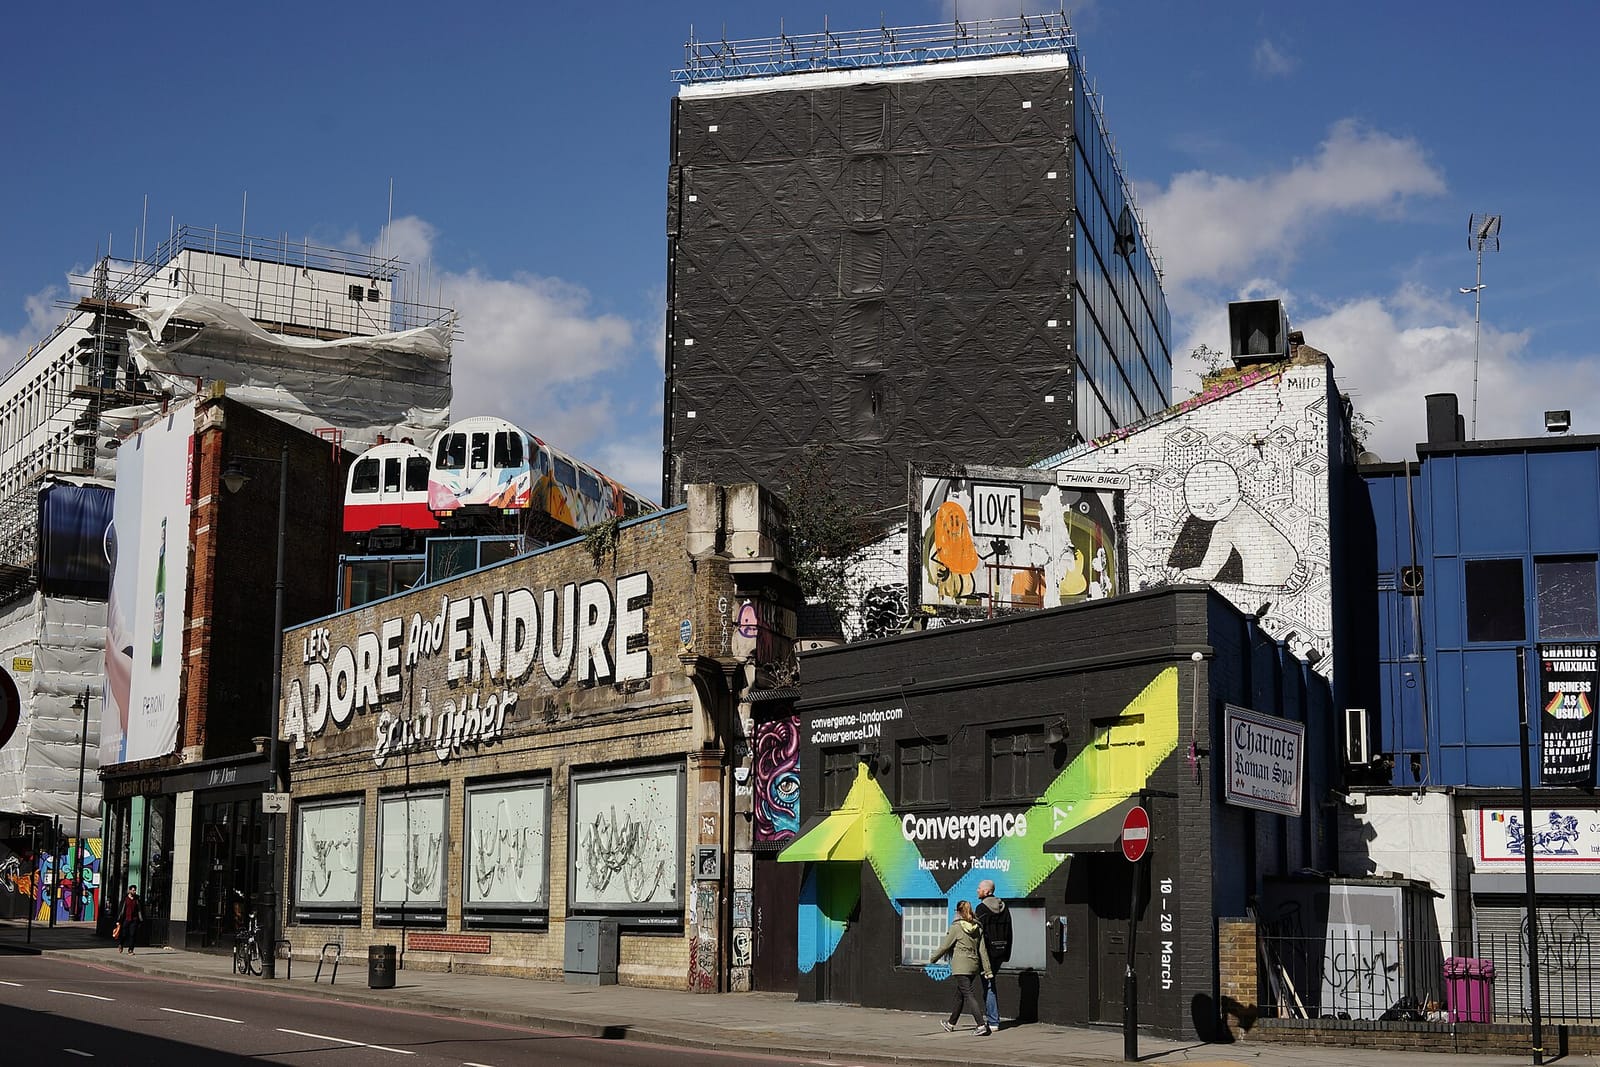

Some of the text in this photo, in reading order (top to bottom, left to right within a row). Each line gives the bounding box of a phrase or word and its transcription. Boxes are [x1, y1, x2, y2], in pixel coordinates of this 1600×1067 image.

[1097, 476, 1127, 486] BIKE!!
[979, 493, 1018, 528] LOVE
[303, 627, 331, 664] LETS
[1542, 645, 1597, 658] CHARIOTS
[283, 571, 652, 752] ADORE And ENDURE
[1553, 661, 1597, 672] VAUXHALL
[1548, 681, 1592, 693] BUSINESS
[1564, 694, 1577, 706] AS
[811, 708, 903, 729] convergence-london.com
[1555, 708, 1585, 719] USUAL
[1234, 721, 1295, 761] Chariots
[1543, 745, 1592, 756] EMBANKMENT
[1234, 751, 1293, 788] Roman Spa
[901, 812, 1028, 848] Convergence
[918, 857, 939, 871] Music
[948, 856, 960, 870] Art
[969, 855, 1011, 872] Technology
[1160, 877, 1173, 894] 10
[1160, 913, 1173, 933] 20
[1160, 941, 1174, 990] March
